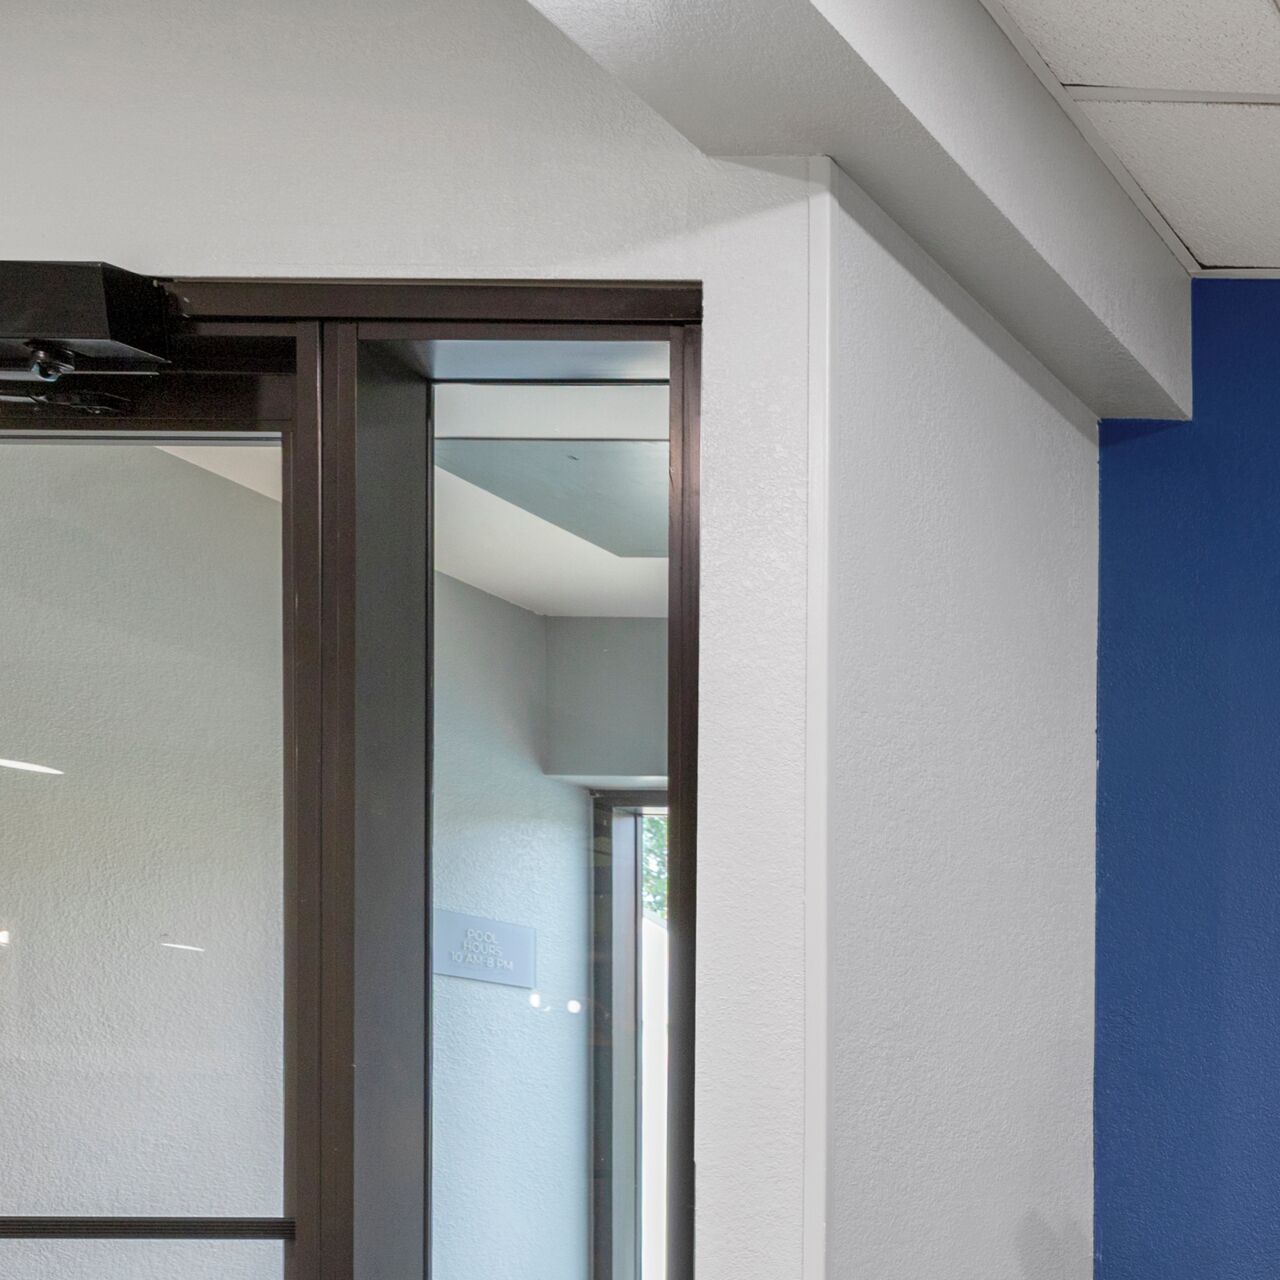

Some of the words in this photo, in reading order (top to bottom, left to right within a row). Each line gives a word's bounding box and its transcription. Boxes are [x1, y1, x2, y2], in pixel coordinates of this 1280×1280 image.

[466, 928, 498, 944] POOL
[463, 940, 503, 957] HOURS
[451, 951, 463, 962] 10
[496, 959, 513, 970] PM
